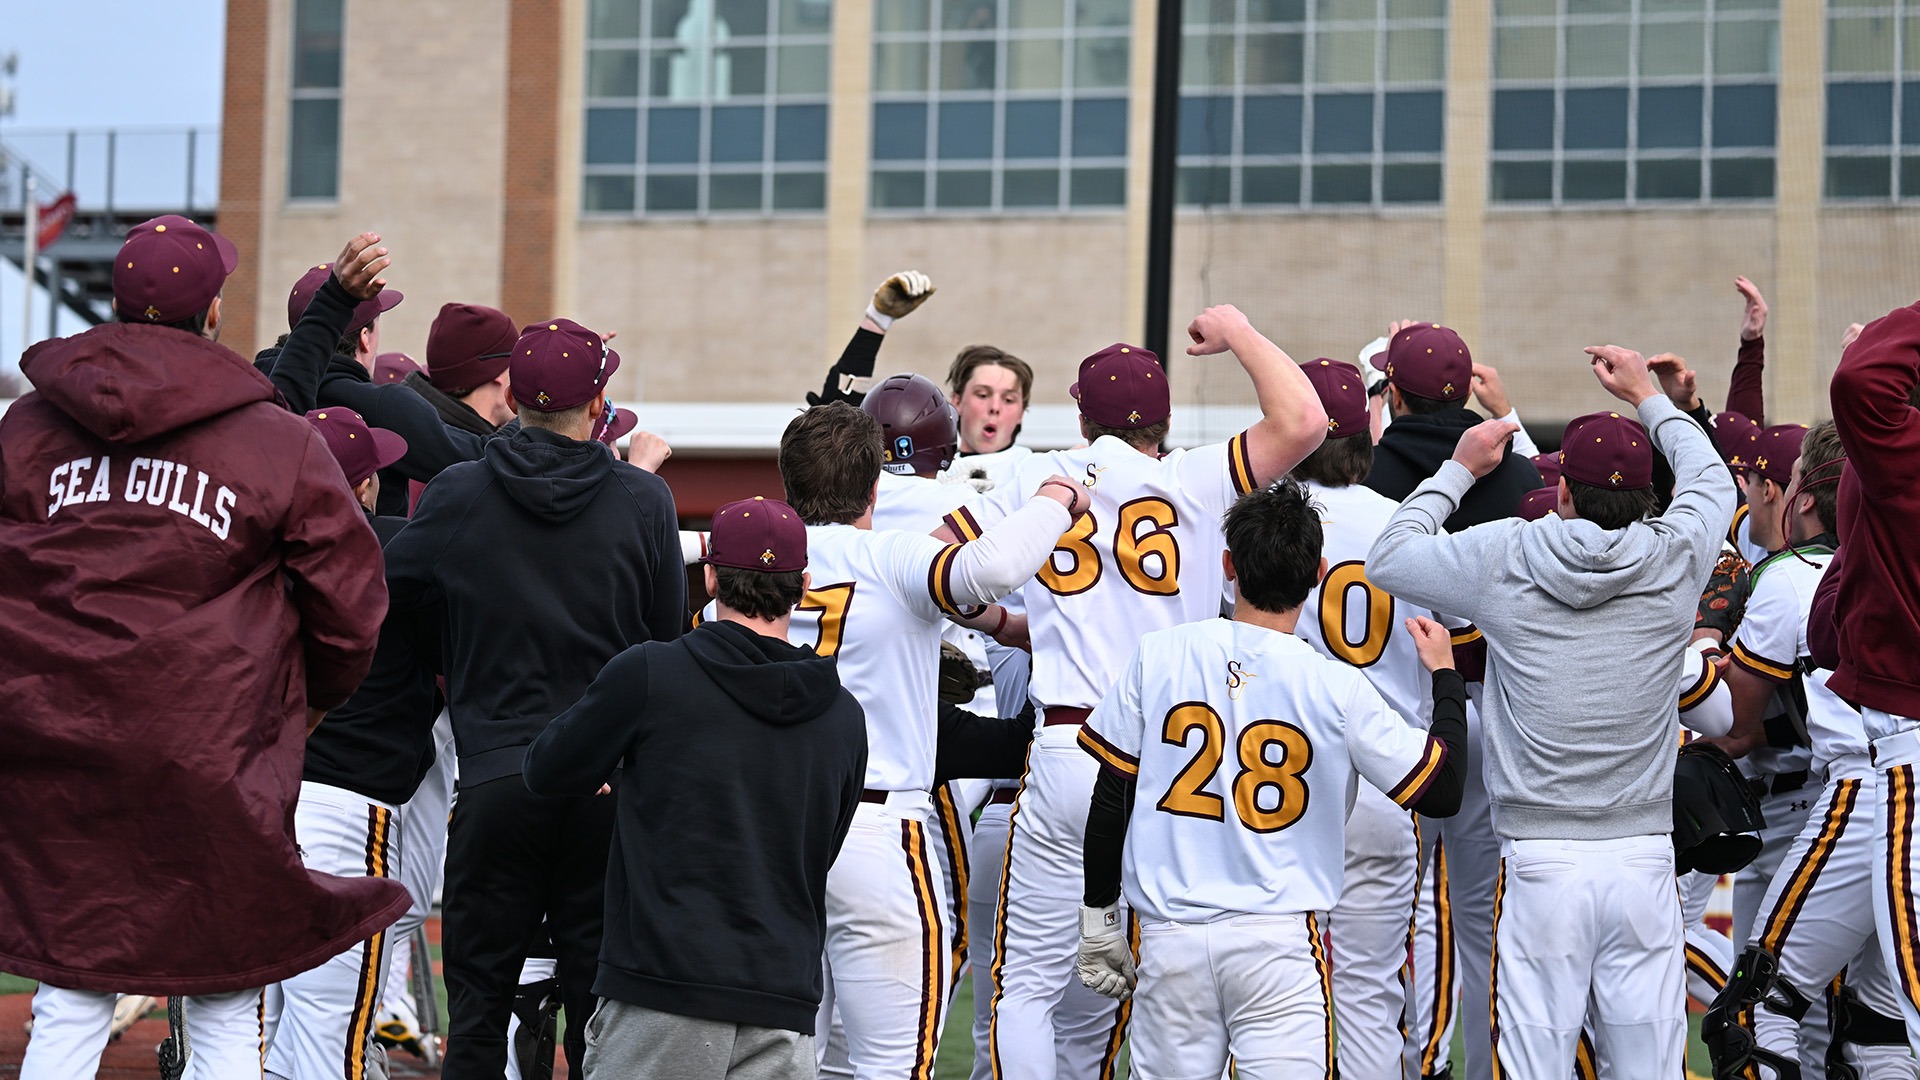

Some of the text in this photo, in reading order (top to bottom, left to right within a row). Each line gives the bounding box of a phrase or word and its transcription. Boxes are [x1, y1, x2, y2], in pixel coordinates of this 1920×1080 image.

[48, 456, 237, 541] SEA GULLS
[882, 464, 905, 472] chutt
[794, 582, 856, 664] 7
[1156, 701, 1313, 834] 28
